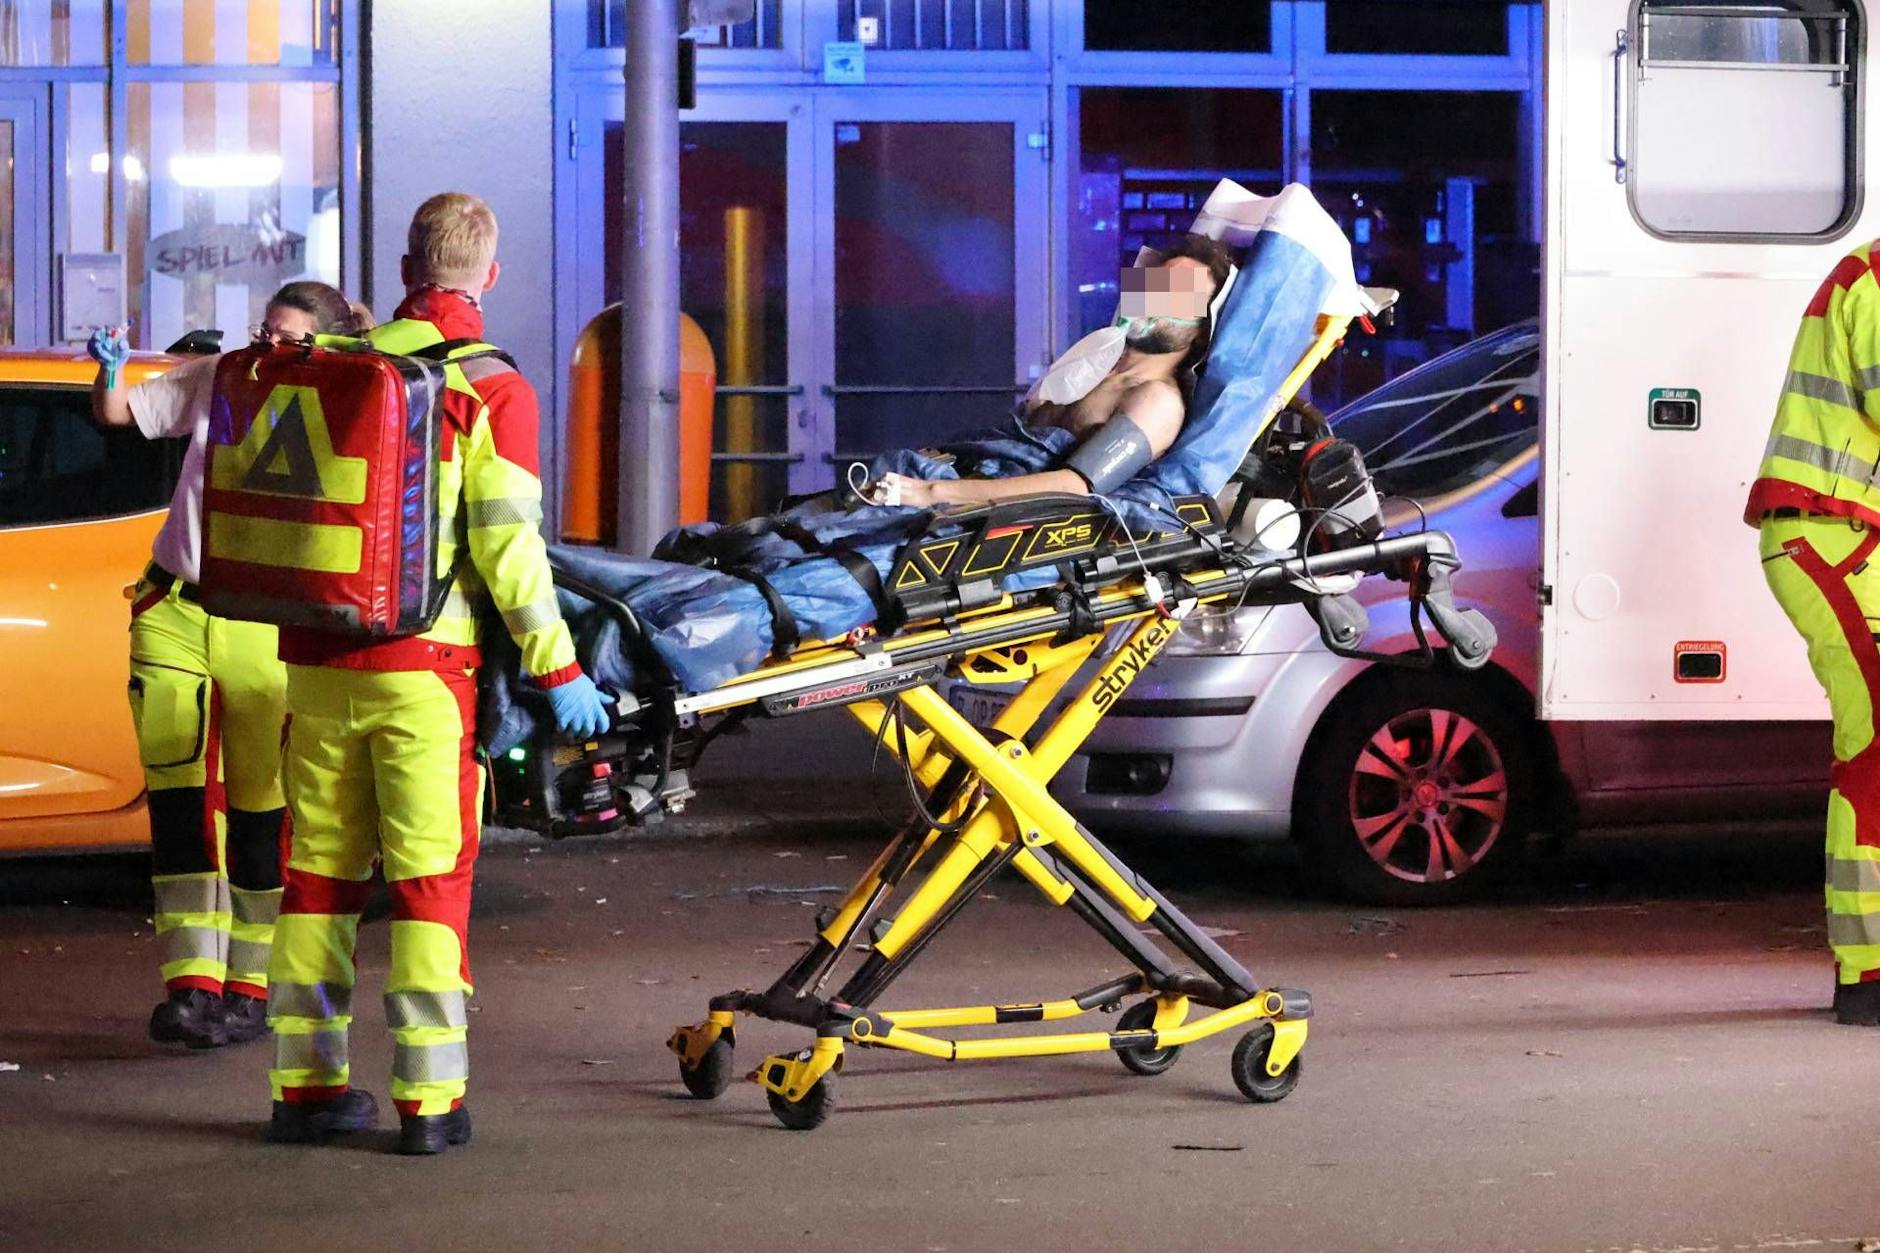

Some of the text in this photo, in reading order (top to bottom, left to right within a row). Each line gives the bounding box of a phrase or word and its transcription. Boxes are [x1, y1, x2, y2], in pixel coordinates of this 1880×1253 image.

[157, 245, 247, 273] SPIEL
[1676, 390, 1688, 398] AUF
[1046, 524, 1091, 545] XPS
[1676, 642, 1724, 651] ENTRIEGELUNG
[1092, 617, 1171, 714] stryker
